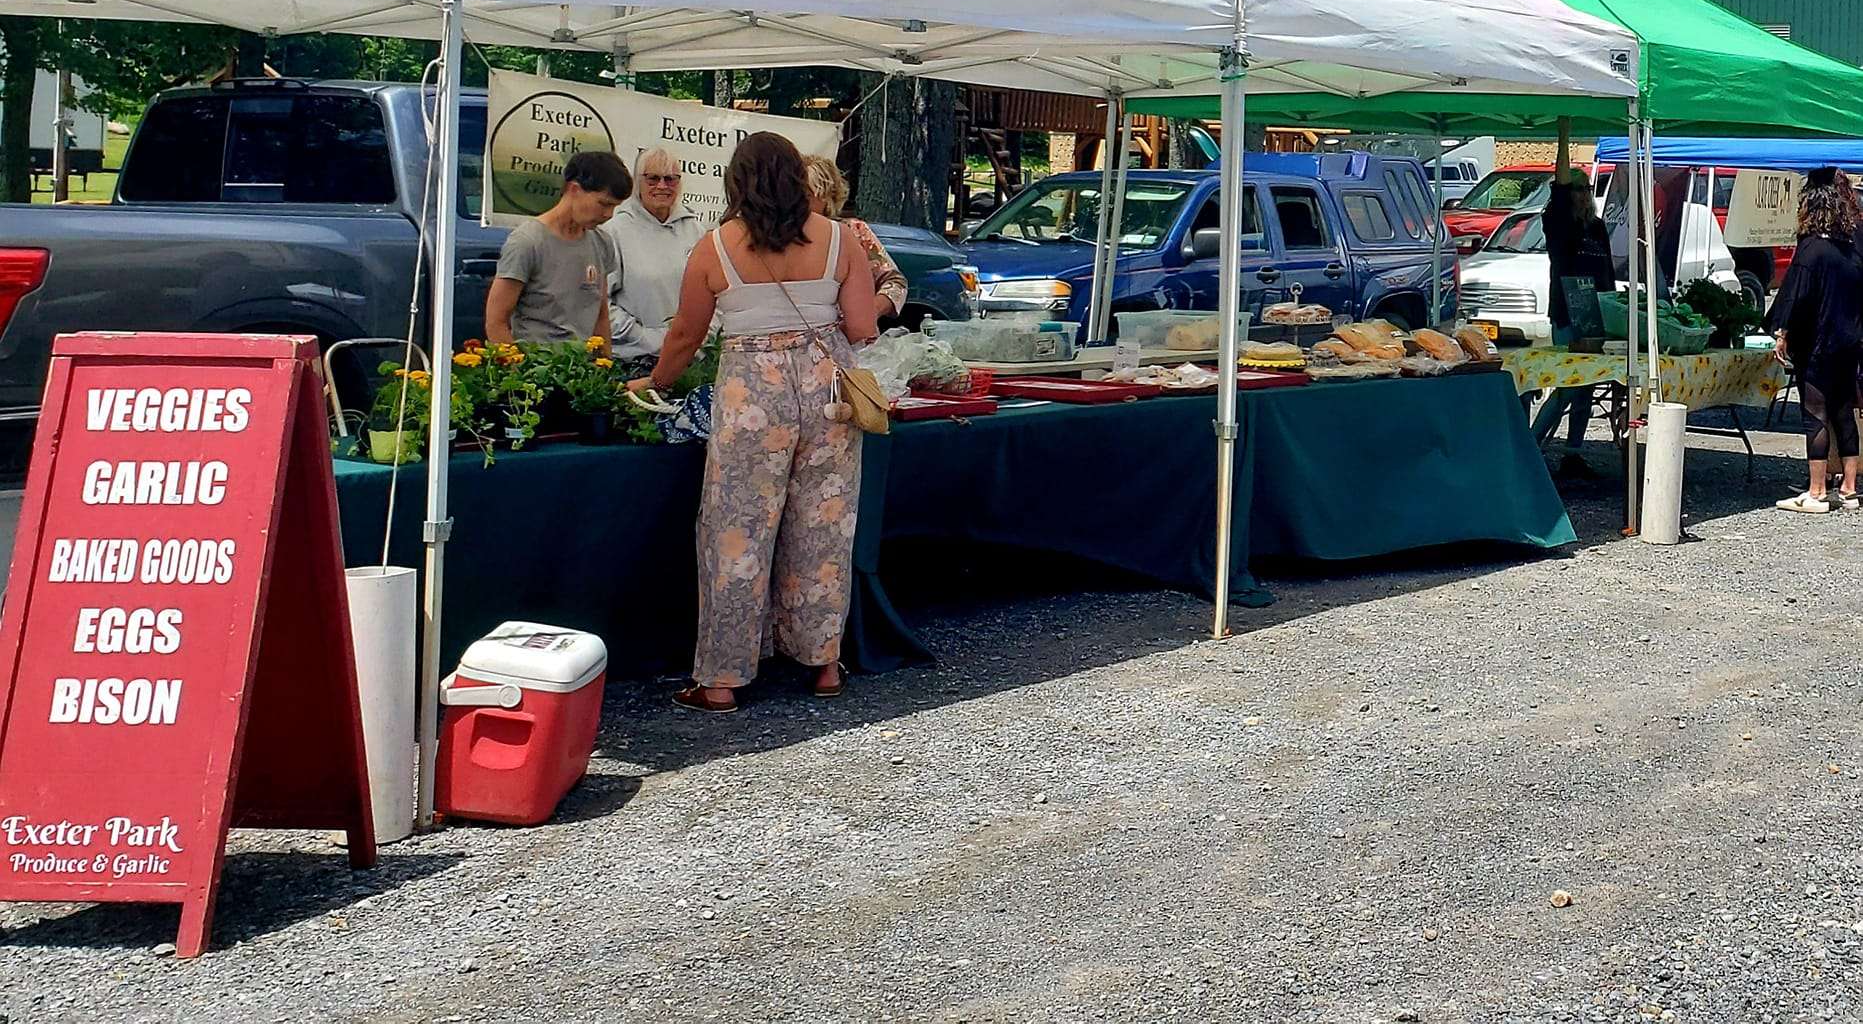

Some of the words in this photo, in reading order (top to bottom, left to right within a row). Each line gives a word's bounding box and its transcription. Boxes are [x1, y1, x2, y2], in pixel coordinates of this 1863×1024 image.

[531, 103, 592, 128] Exeter
[661, 117, 728, 147] Exeter
[536, 132, 582, 154] Park
[510, 156, 564, 175] Produ
[86, 388, 251, 432] VEGGIES
[82, 460, 228, 505] GARLIC
[49, 539, 137, 583] BAKED
[141, 539, 235, 584] GOODS
[73, 607, 183, 654] EGGS
[49, 677, 183, 725] BISON
[1, 816, 99, 846] Exeter
[105, 816, 183, 852] Park
[10, 853, 88, 873] Produce
[92, 854, 108, 873] &
[112, 854, 170, 878] Garlic
